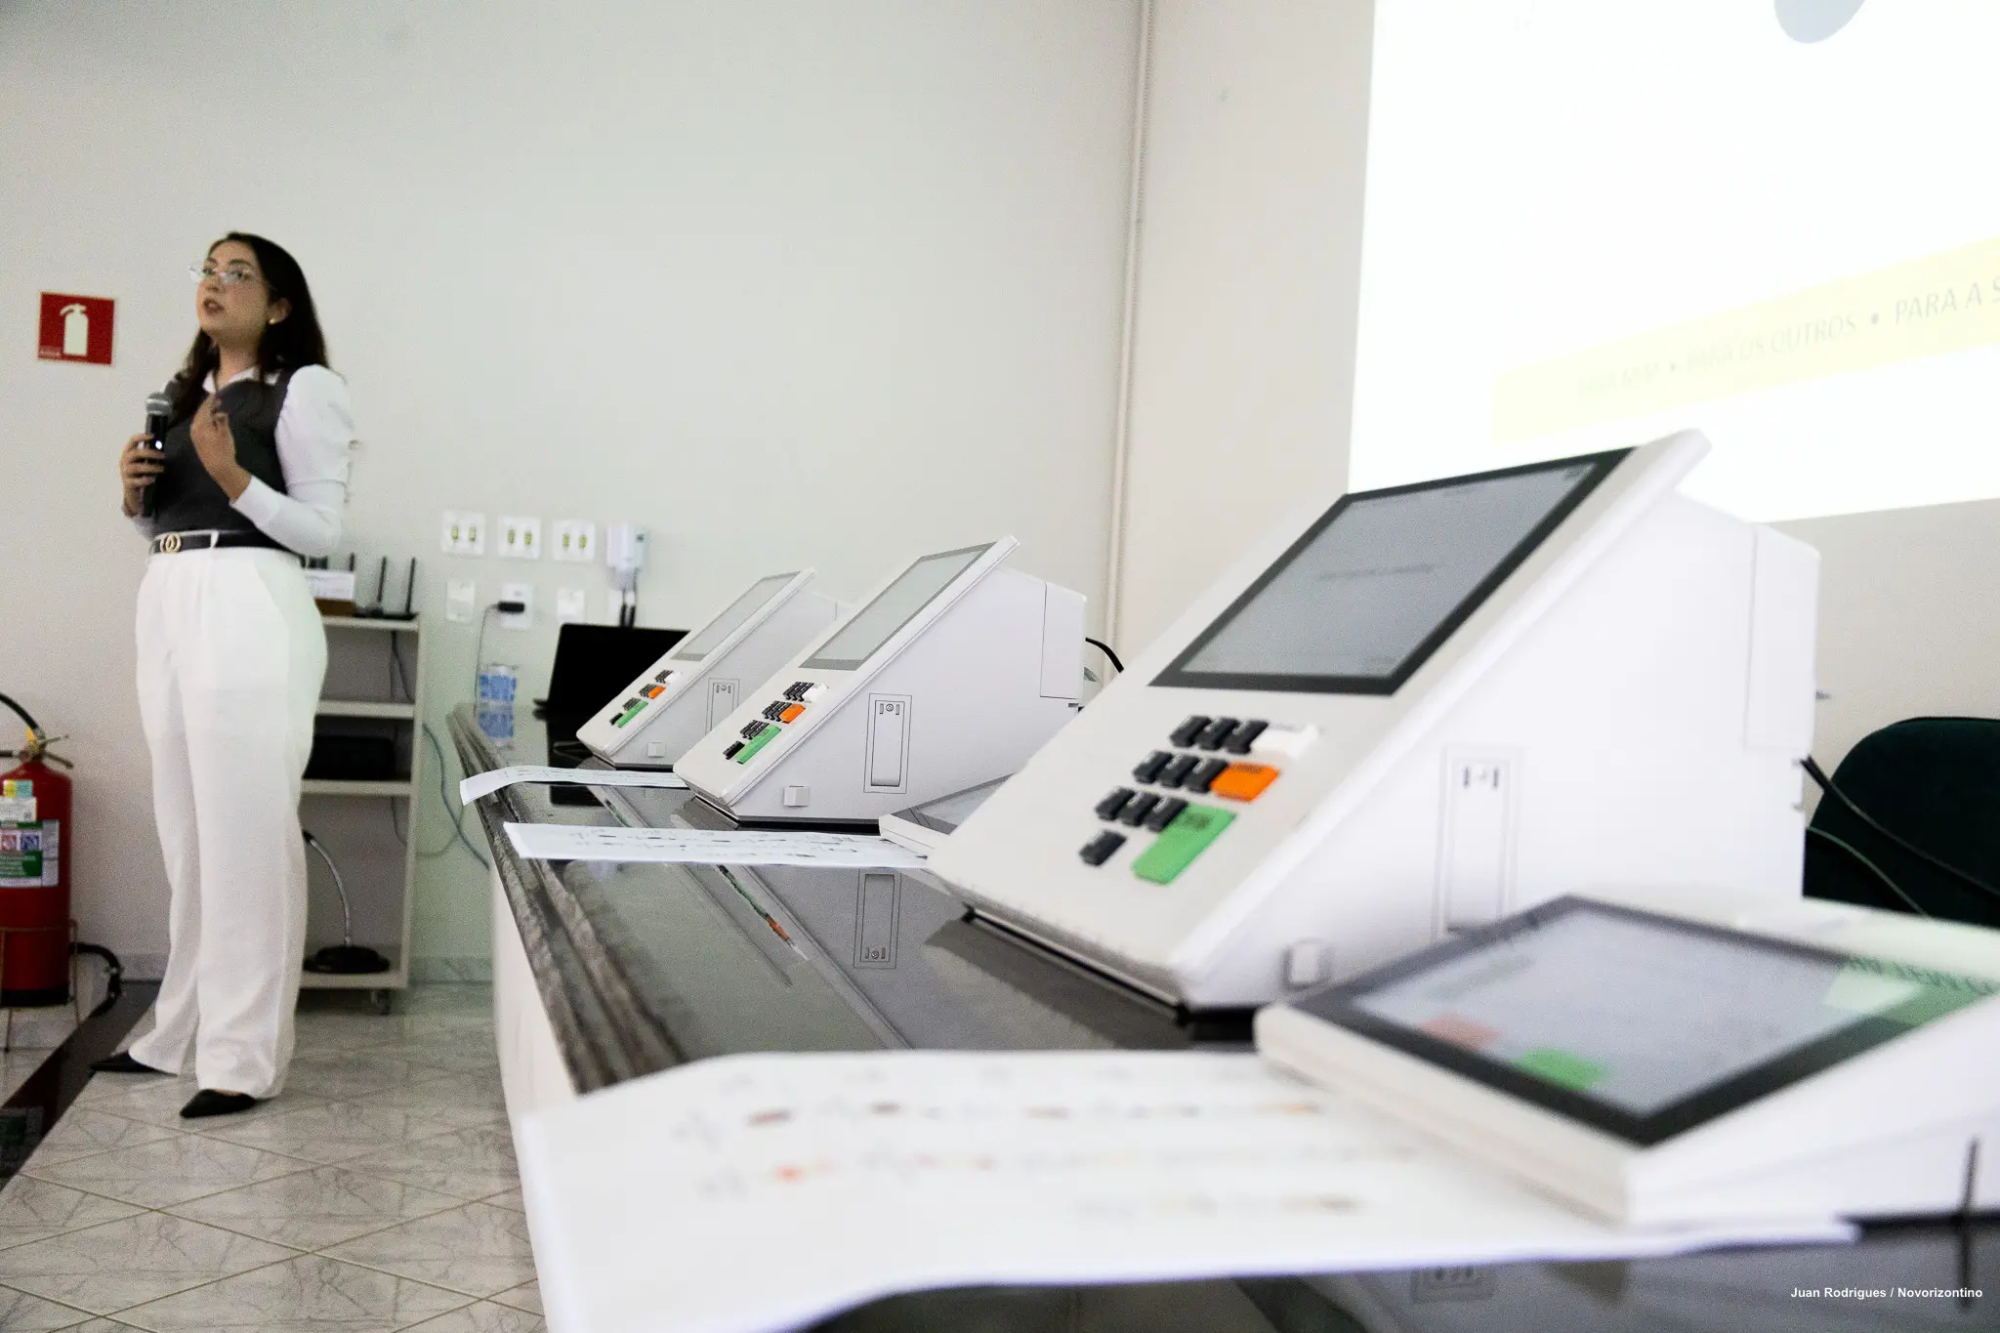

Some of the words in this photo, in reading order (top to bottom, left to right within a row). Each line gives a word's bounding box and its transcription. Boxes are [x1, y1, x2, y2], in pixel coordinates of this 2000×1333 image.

[1771, 313, 1857, 354] OUTROS
[1895, 286, 1958, 325] PARA
[1965, 280, 1982, 309] A
